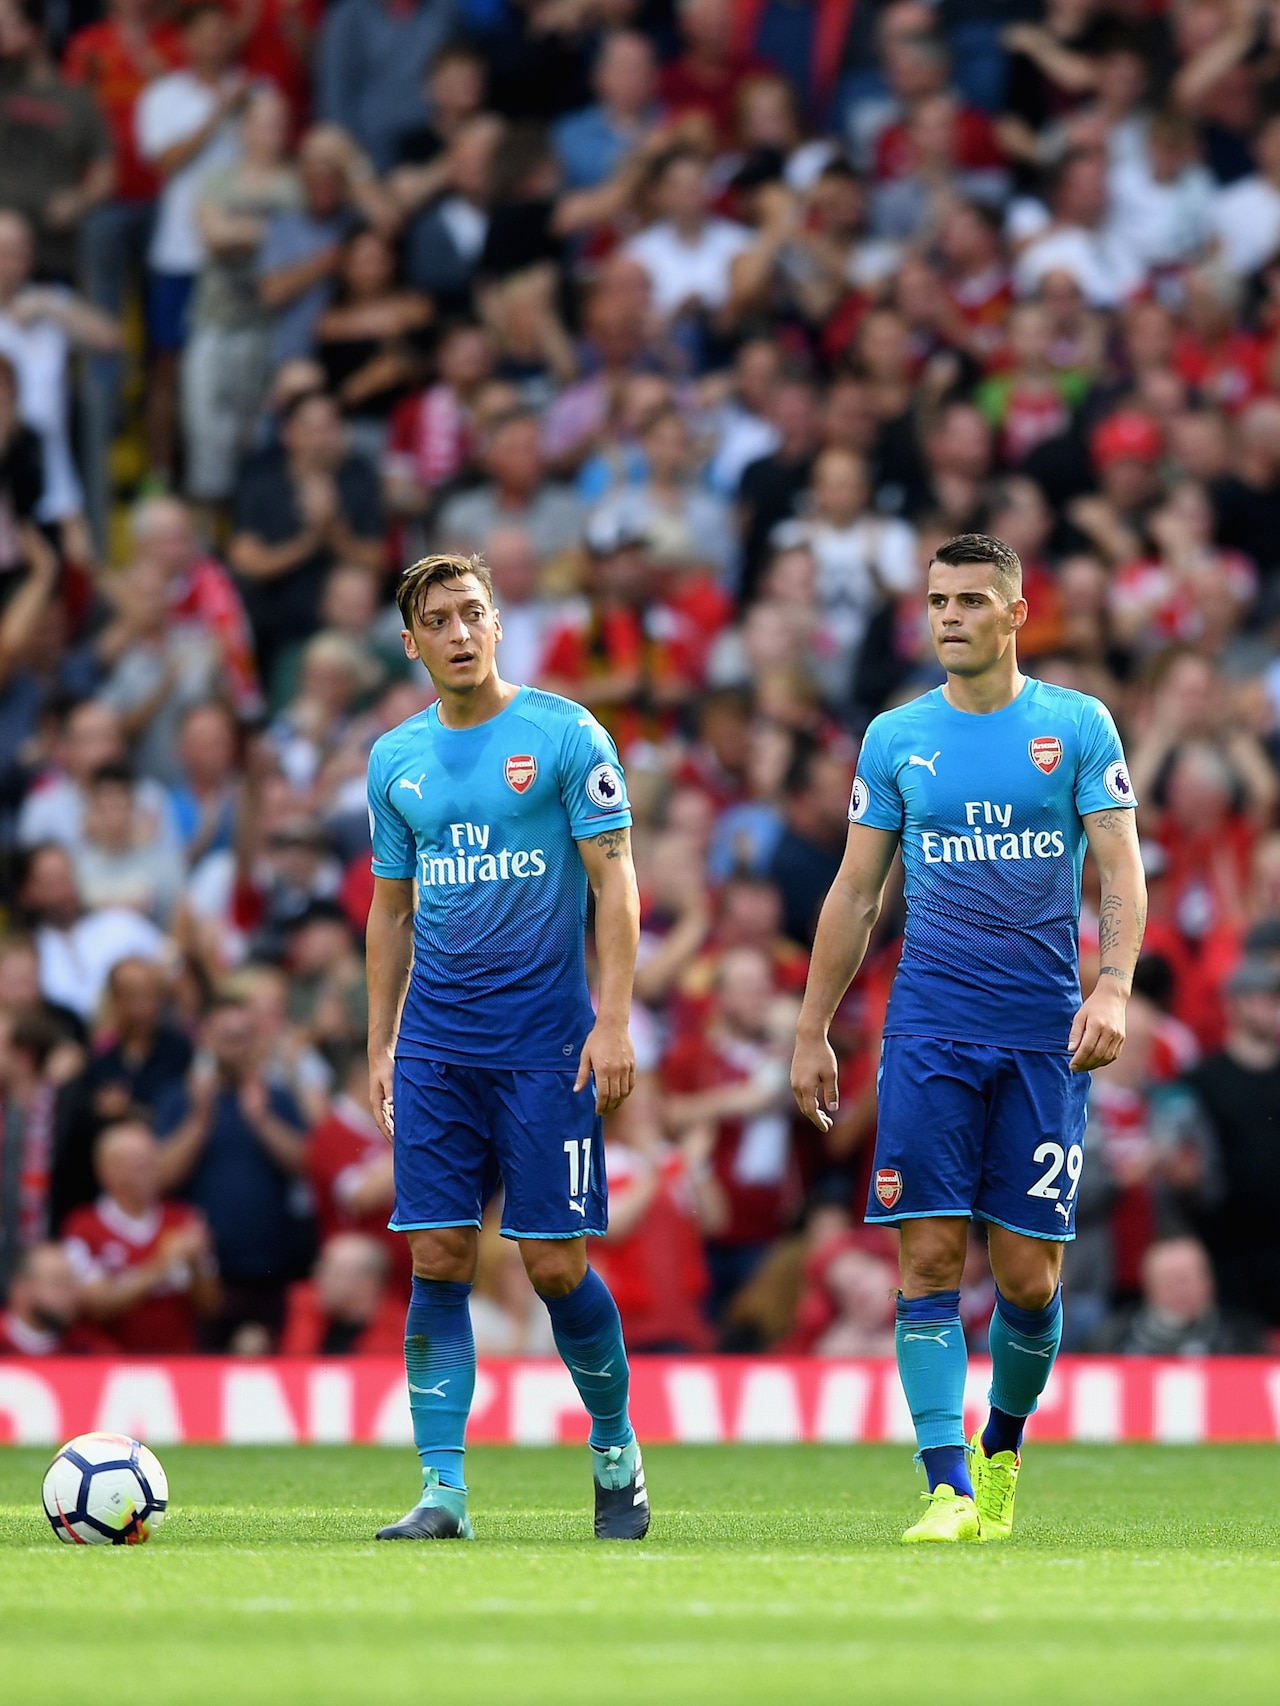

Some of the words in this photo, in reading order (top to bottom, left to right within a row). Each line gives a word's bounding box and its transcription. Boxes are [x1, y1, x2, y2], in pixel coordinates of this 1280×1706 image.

[963, 800, 1013, 828] Fly
[449, 822, 490, 849] Fly
[920, 826, 1065, 863] Emirates
[420, 848, 547, 886] Emirates
[563, 1137, 592, 1197] 11
[1026, 1141, 1083, 1200] 29
